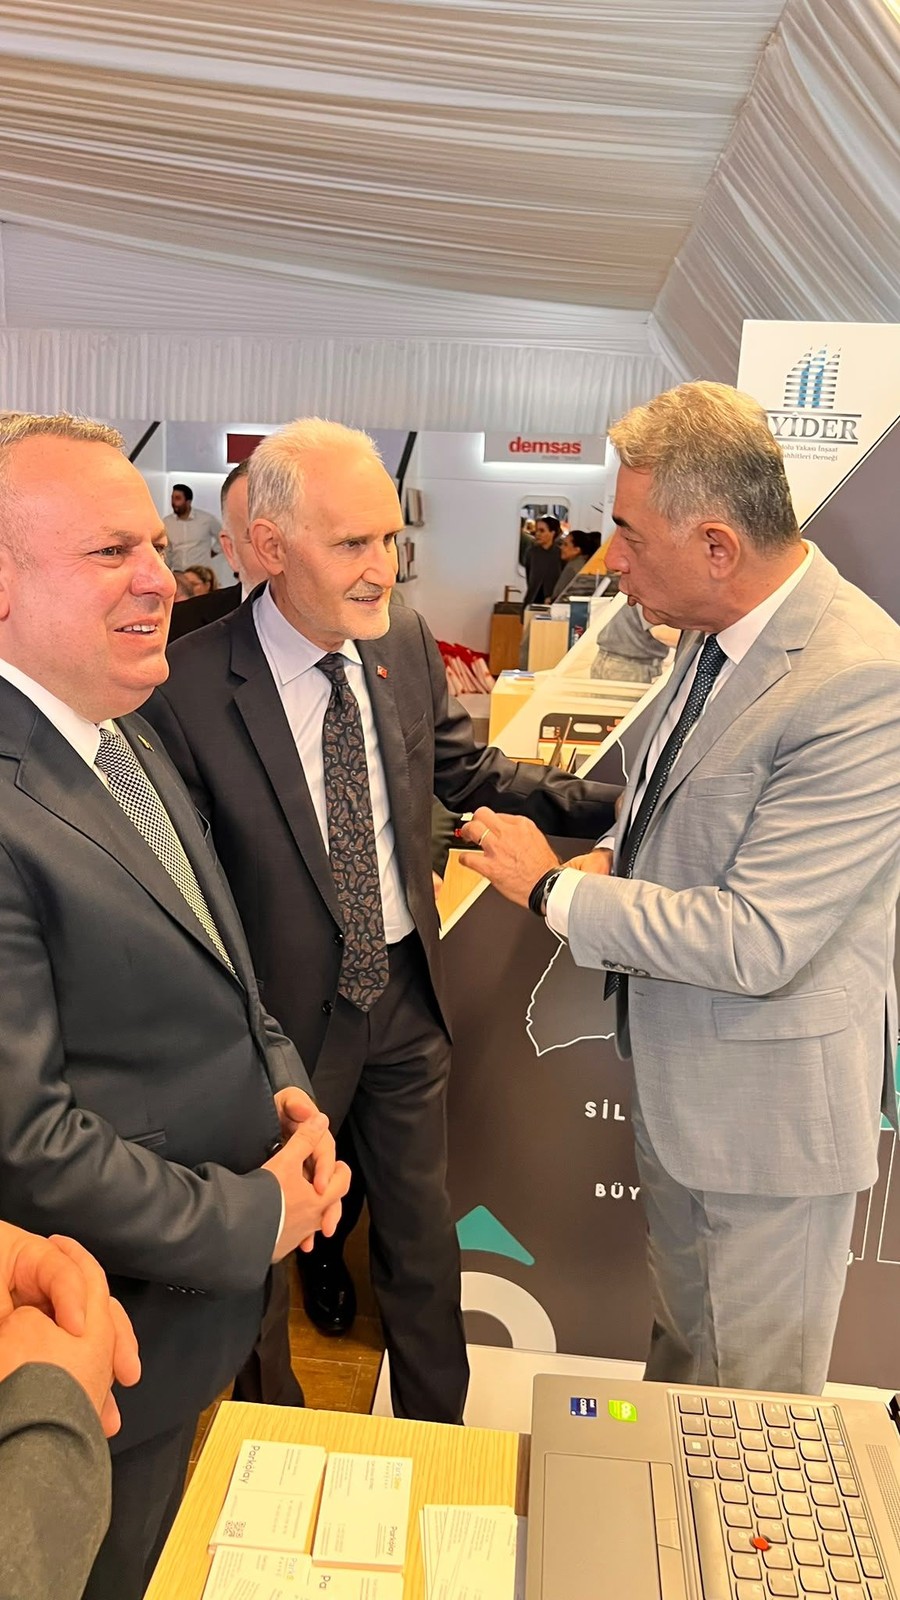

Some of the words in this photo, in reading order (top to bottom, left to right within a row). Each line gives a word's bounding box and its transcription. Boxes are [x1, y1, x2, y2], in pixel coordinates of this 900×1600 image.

[508, 436, 582, 454] demsas
[584, 1099, 626, 1121] SİL
[594, 1182, 641, 1201] BÜY
